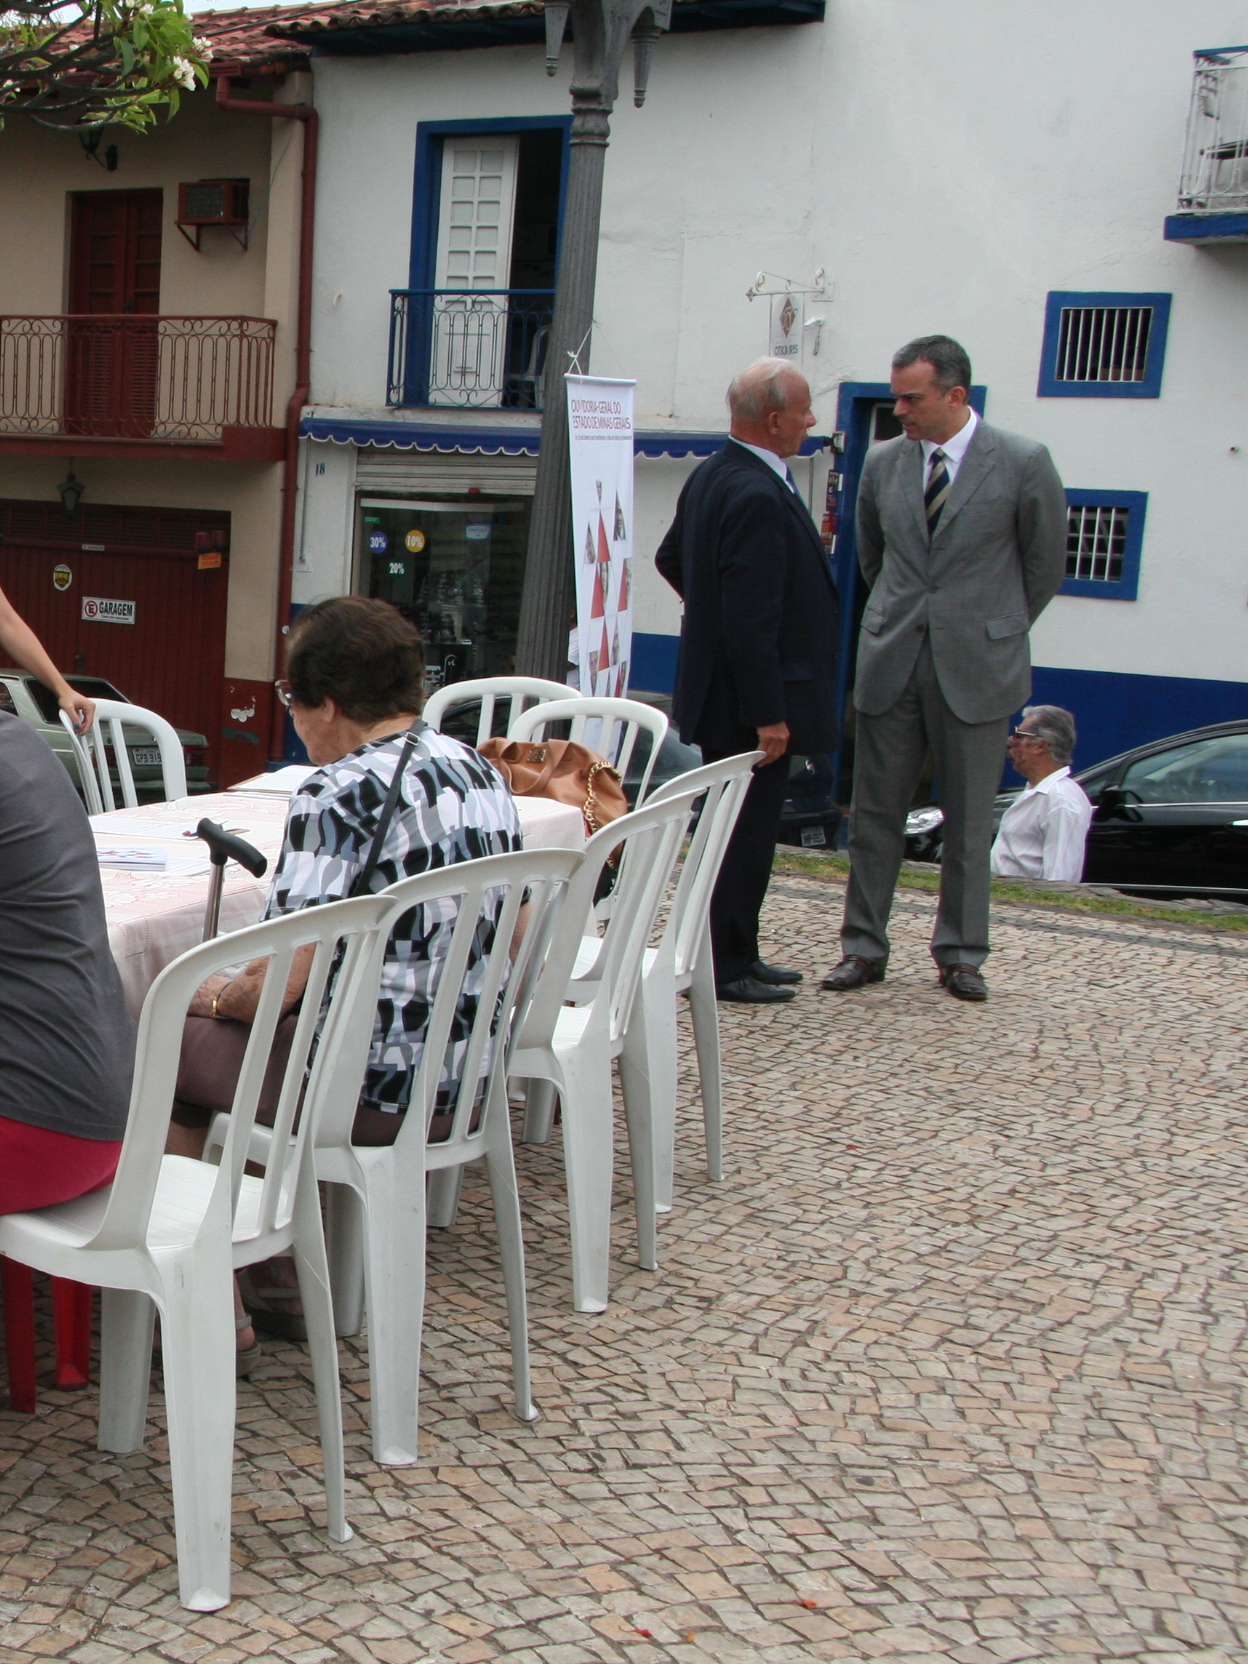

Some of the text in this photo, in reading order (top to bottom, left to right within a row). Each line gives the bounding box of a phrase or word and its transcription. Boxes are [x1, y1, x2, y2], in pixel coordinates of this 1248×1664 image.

[613, 401, 621, 415] DO
[572, 415, 592, 429] ESTADO
[613, 416, 631, 430] GERAIS
[315, 462, 325, 477] 18
[369, 536, 387, 549] 30%
[406, 534, 424, 548] 10%
[388, 562, 405, 575] 20%
[98, 600, 133, 617] GARAGEM
[149, 752, 163, 764] 919
